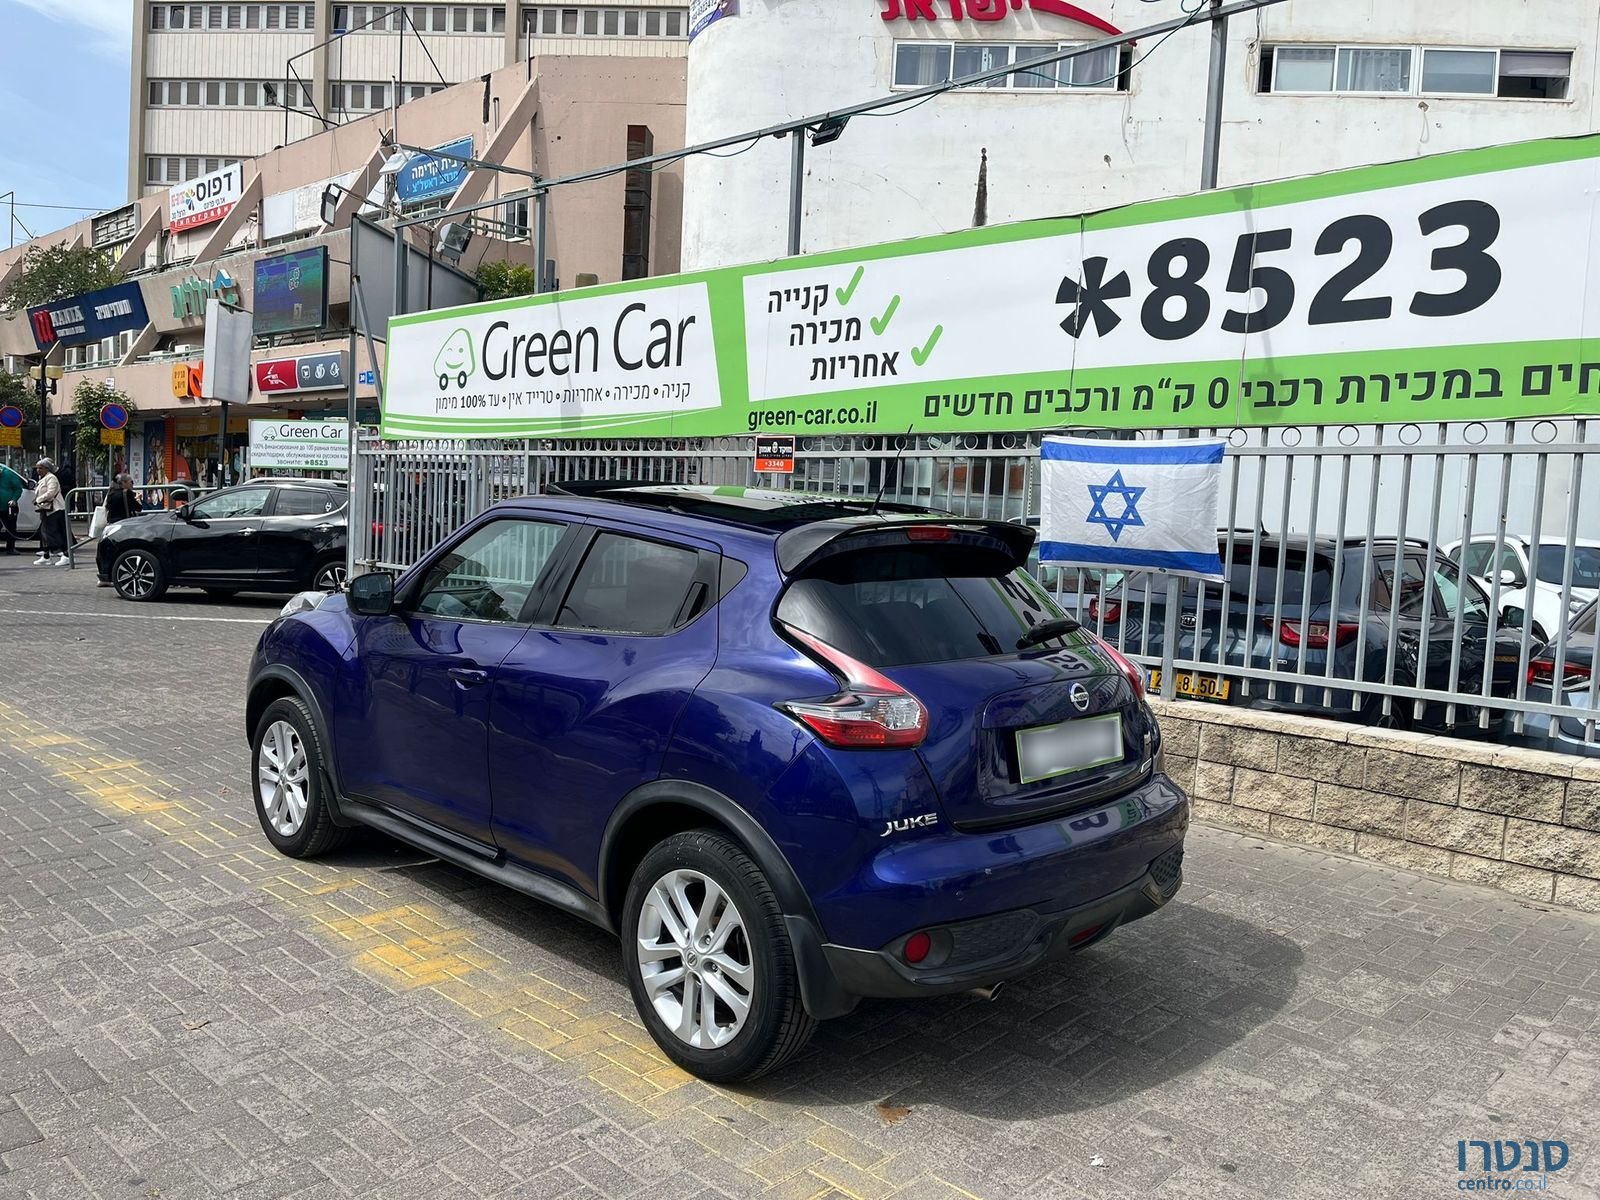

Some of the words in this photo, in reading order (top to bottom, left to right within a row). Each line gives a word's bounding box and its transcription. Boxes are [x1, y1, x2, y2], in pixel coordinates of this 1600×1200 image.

[411, 161, 439, 179] קדימה
[196, 172, 233, 202] דפוס
[767, 283, 829, 315] קנייה
[482, 320, 599, 381] Green
[613, 302, 696, 371] Car
[790, 317, 861, 346] מכירה
[810, 351, 900, 380] אחריות
[526, 389, 554, 405] טרייד
[562, 387, 603, 404] אחריות
[613, 384, 650, 401] מכירה
[661, 382, 691, 403] קניה
[1208, 377, 1229, 409] 0
[1241, 378, 1323, 407] רכבי
[1336, 368, 1504, 404] במכירת
[435, 396, 458, 413] מימון
[460, 394, 487, 409] 100%
[487, 393, 500, 407] עד
[508, 391, 522, 410] אין
[924, 392, 1013, 417] חדשים
[1024, 387, 1121, 414] ורכבים
[748, 401, 877, 431] green-car.co.il
[279, 424, 318, 438] Green
[321, 425, 343, 438] Car
[880, 812, 938, 837] JUKE
